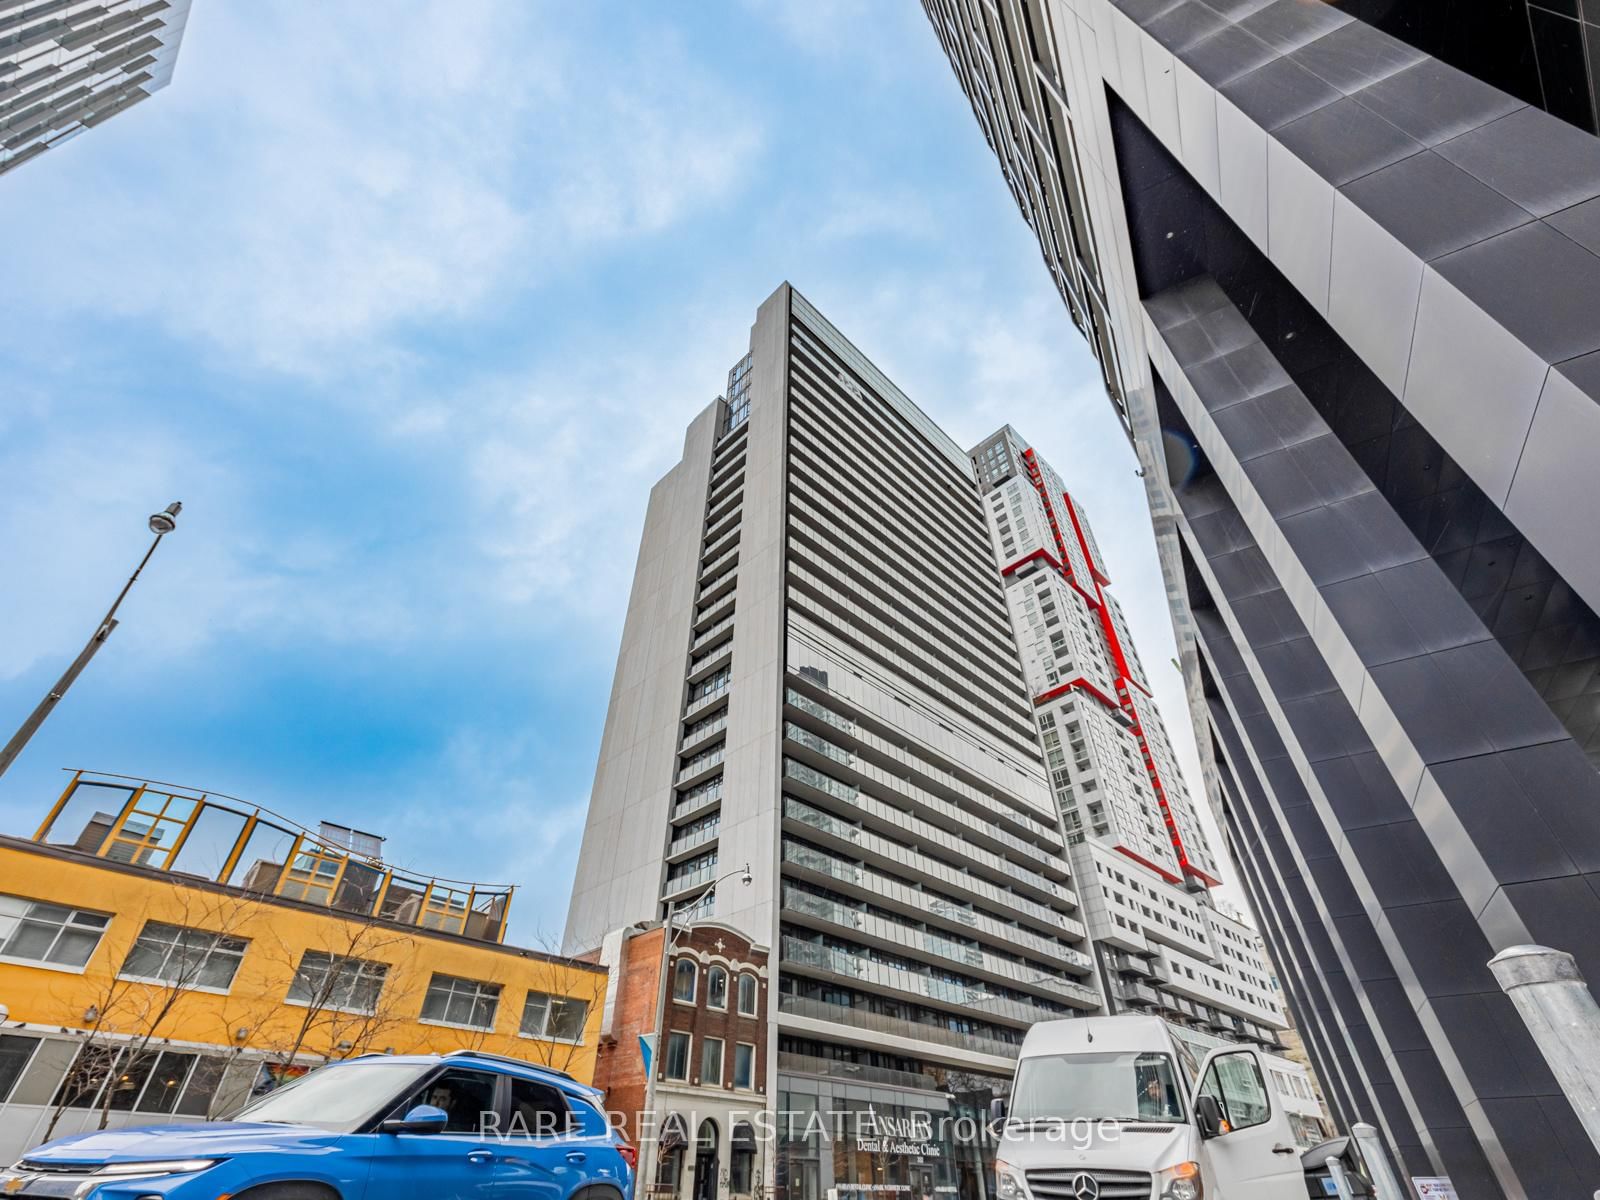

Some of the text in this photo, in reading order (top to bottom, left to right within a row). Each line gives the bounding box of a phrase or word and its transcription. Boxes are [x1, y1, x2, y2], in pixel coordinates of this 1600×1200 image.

[857, 1138, 880, 1152] Dental
[889, 1141, 920, 1155] Aesthetic
[921, 1143, 940, 1157] Clinic
